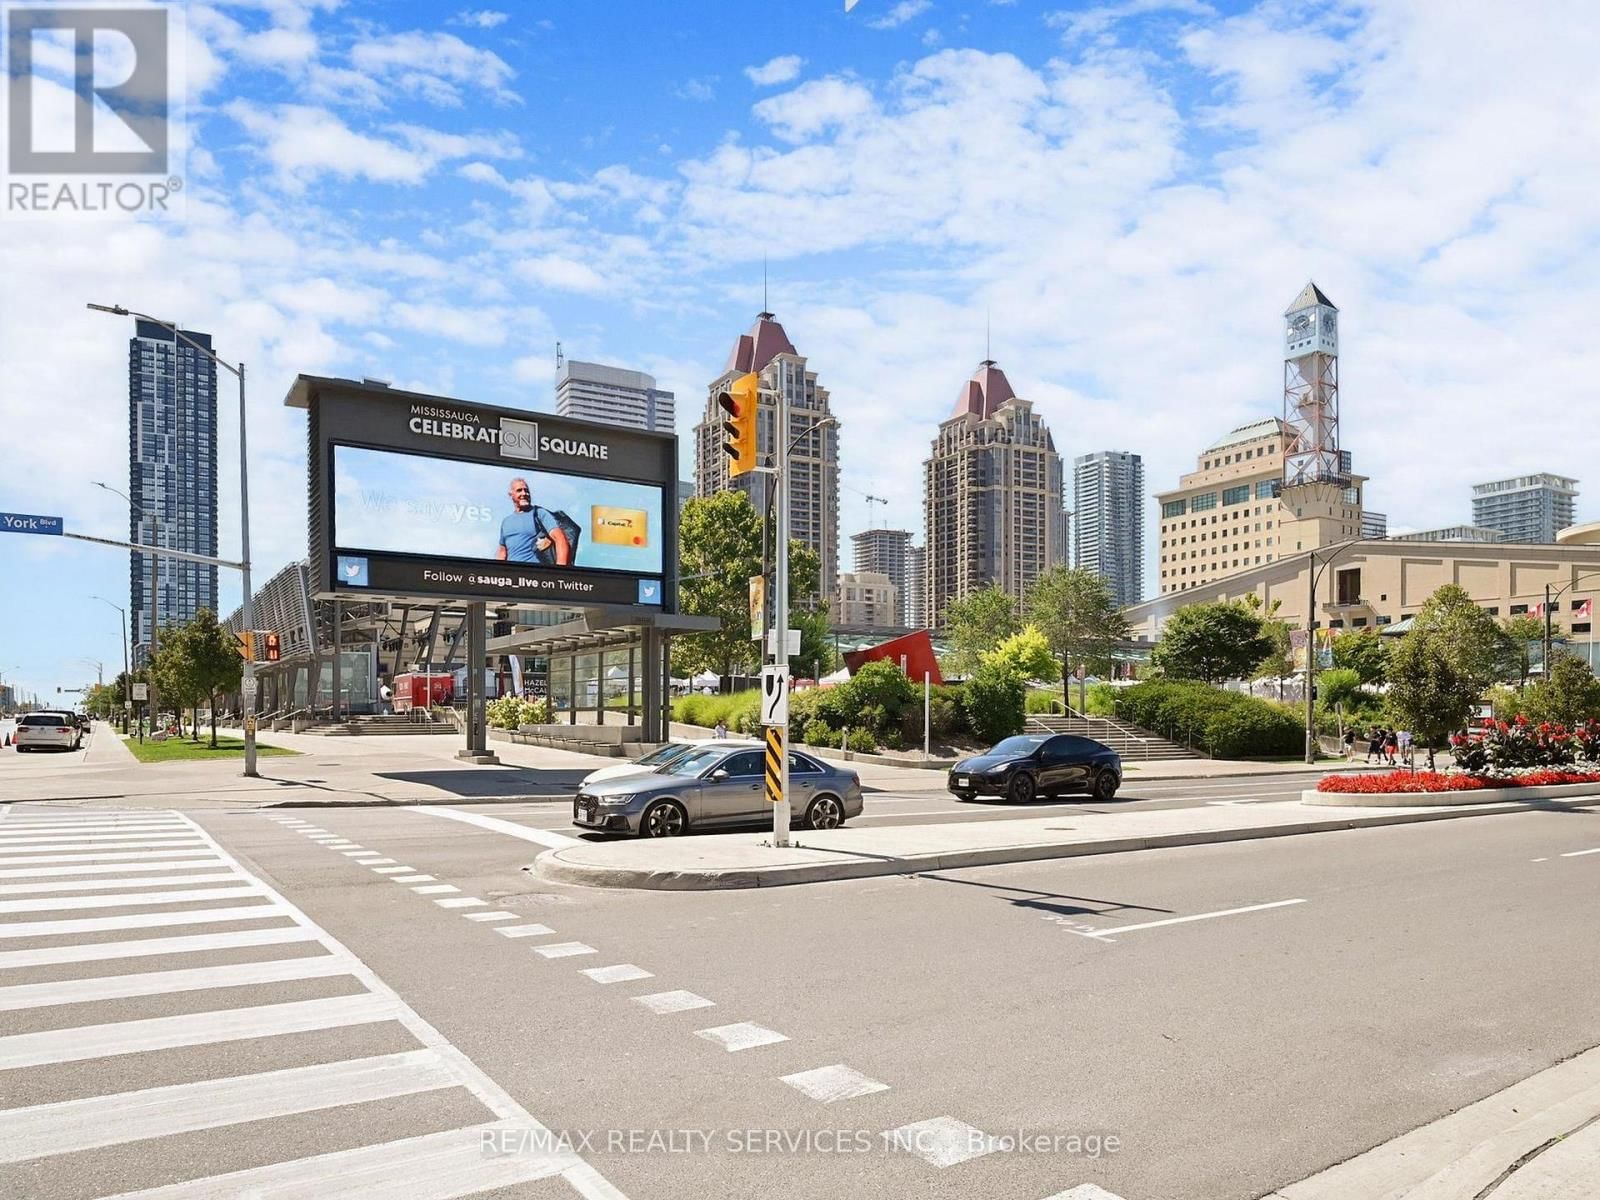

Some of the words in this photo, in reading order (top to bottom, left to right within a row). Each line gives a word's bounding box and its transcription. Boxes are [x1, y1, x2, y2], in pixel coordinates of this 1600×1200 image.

[410, 404, 480, 424] MISSISSAUGA
[409, 417, 533, 449] CELEBRATION
[540, 436, 609, 460] SQUARE
[4, 515, 38, 529] York
[40, 518, 57, 526] Blvd
[453, 503, 492, 522] yes
[423, 570, 463, 582] Follow
[468, 573, 539, 589] @sauga_live
[541, 581, 555, 589] on
[557, 579, 593, 592] Twitter
[524, 679, 547, 687] HAZEL
